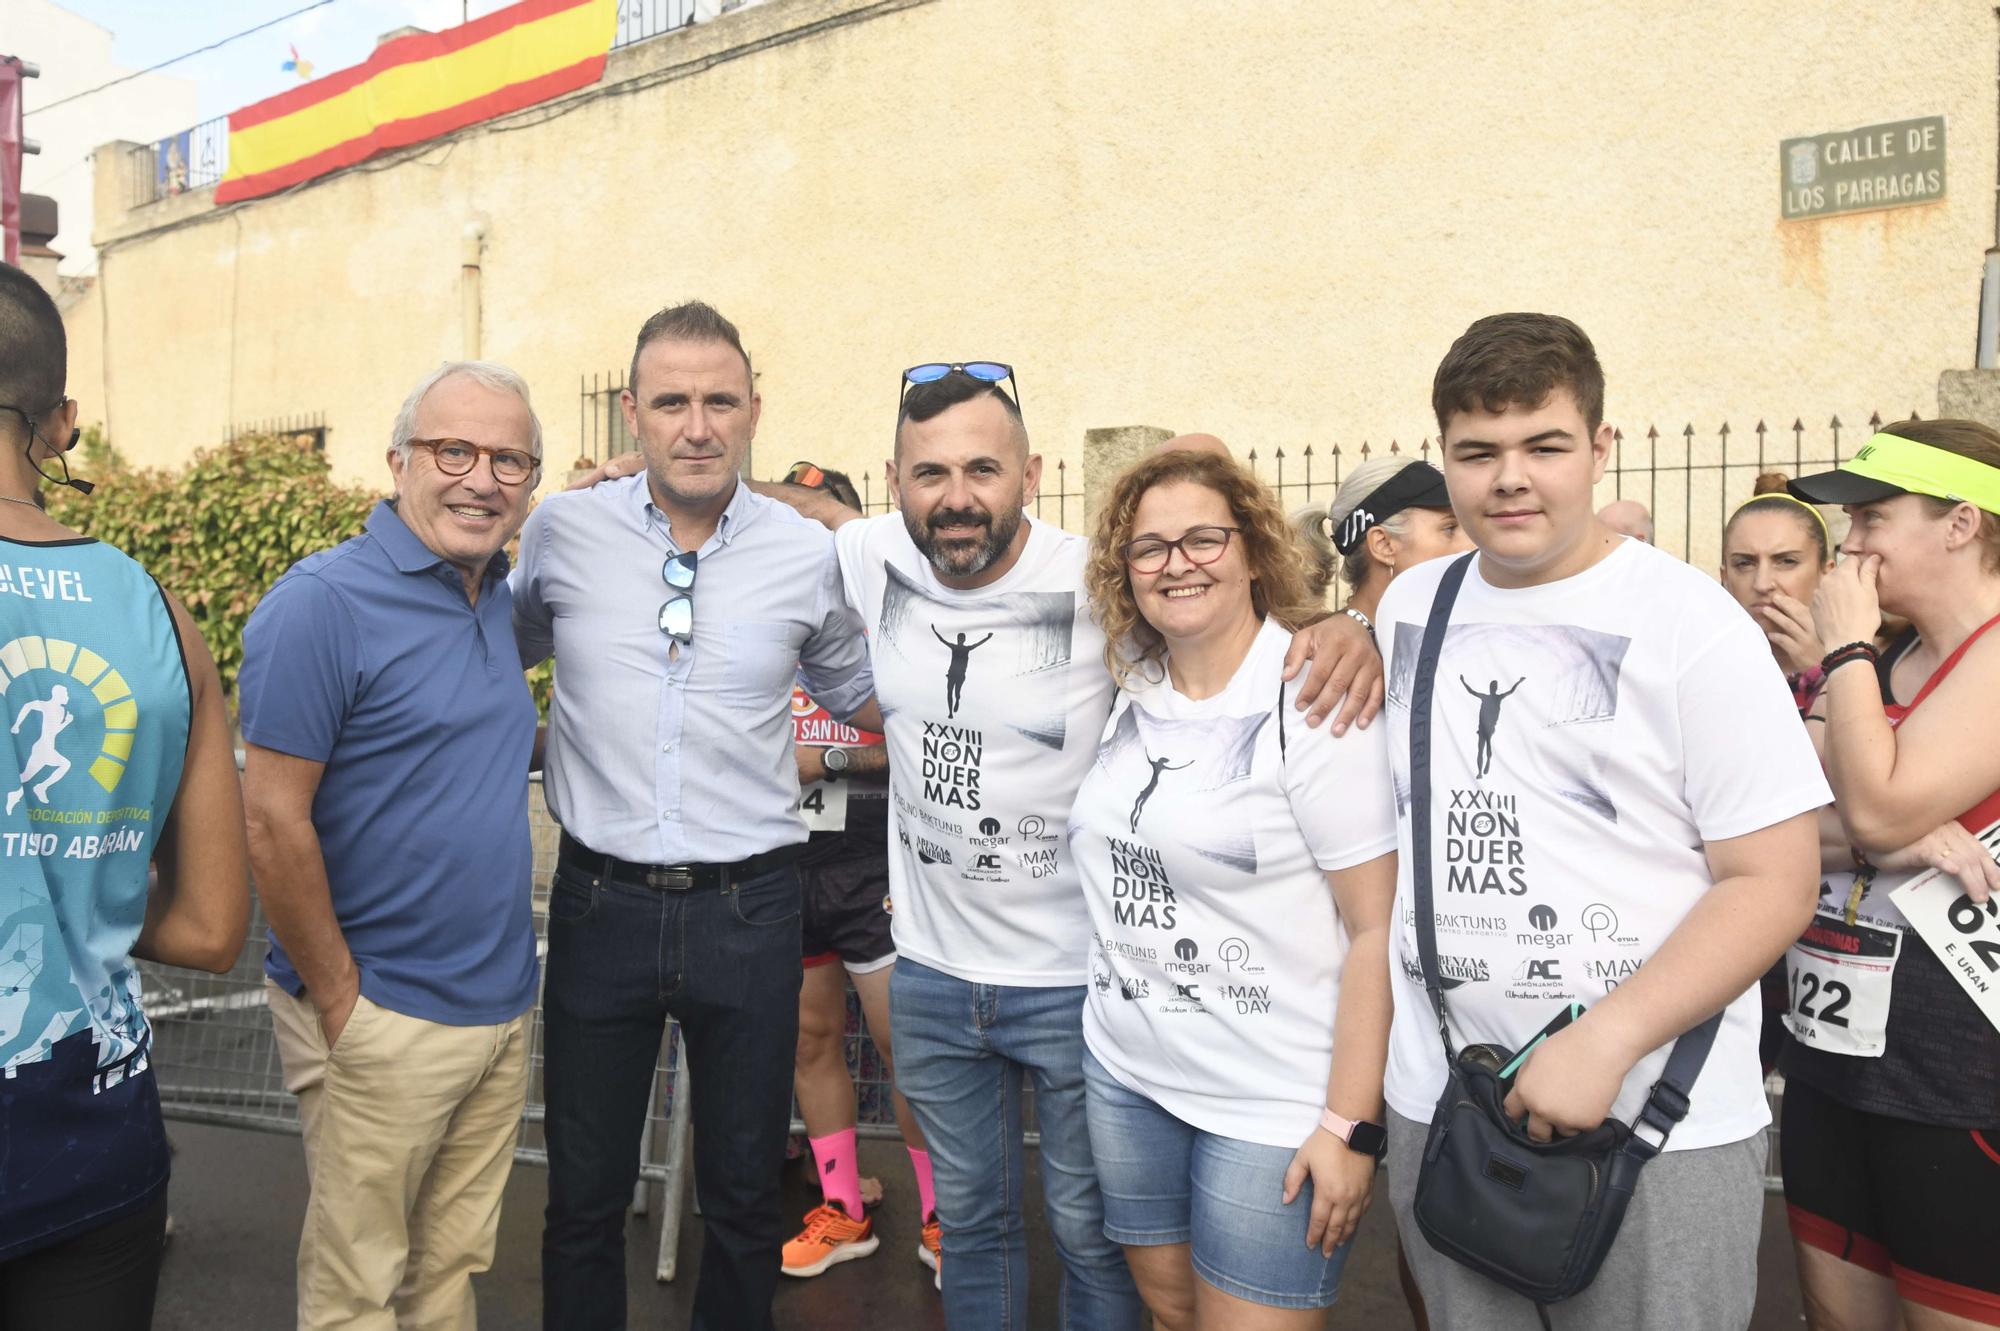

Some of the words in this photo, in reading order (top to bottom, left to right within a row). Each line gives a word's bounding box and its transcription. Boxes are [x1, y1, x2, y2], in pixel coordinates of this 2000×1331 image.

[1824, 132, 1895, 165] CALLE
[1908, 126, 1937, 153] DE
[1787, 186, 1825, 213] LOS
[1835, 169, 1941, 206] PARRAGAS
[801, 719, 860, 742] SANTOS
[923, 720, 982, 746] XXVIII
[922, 737, 983, 767] NON
[922, 758, 981, 789] DUER
[797, 788, 825, 815] 4
[924, 780, 981, 811] MAS
[1449, 789, 1516, 814] XXVIII
[1447, 811, 1521, 837] NON
[64, 825, 145, 859] ABARÁN
[969, 835, 1010, 849] megar
[1106, 835, 1164, 866] XXVIII
[1446, 839, 1525, 866] DUER
[976, 854, 1001, 869] AC
[1023, 847, 1058, 866] MAY
[1111, 853, 1170, 885] NON
[1031, 861, 1059, 879] DAY
[1447, 866, 1528, 896] MAS
[1112, 876, 1177, 904] DUER
[1114, 900, 1177, 930] MAS
[1516, 933, 1574, 949] megar
[1165, 962, 1211, 976] megar
[1526, 959, 1562, 979] AC
[1595, 959, 1643, 977] MAY
[1945, 943, 1957, 958] E.
[1957, 957, 1990, 994] URAN
[1228, 985, 1269, 1000] MAY
[1236, 1000, 1271, 1015] DAY
